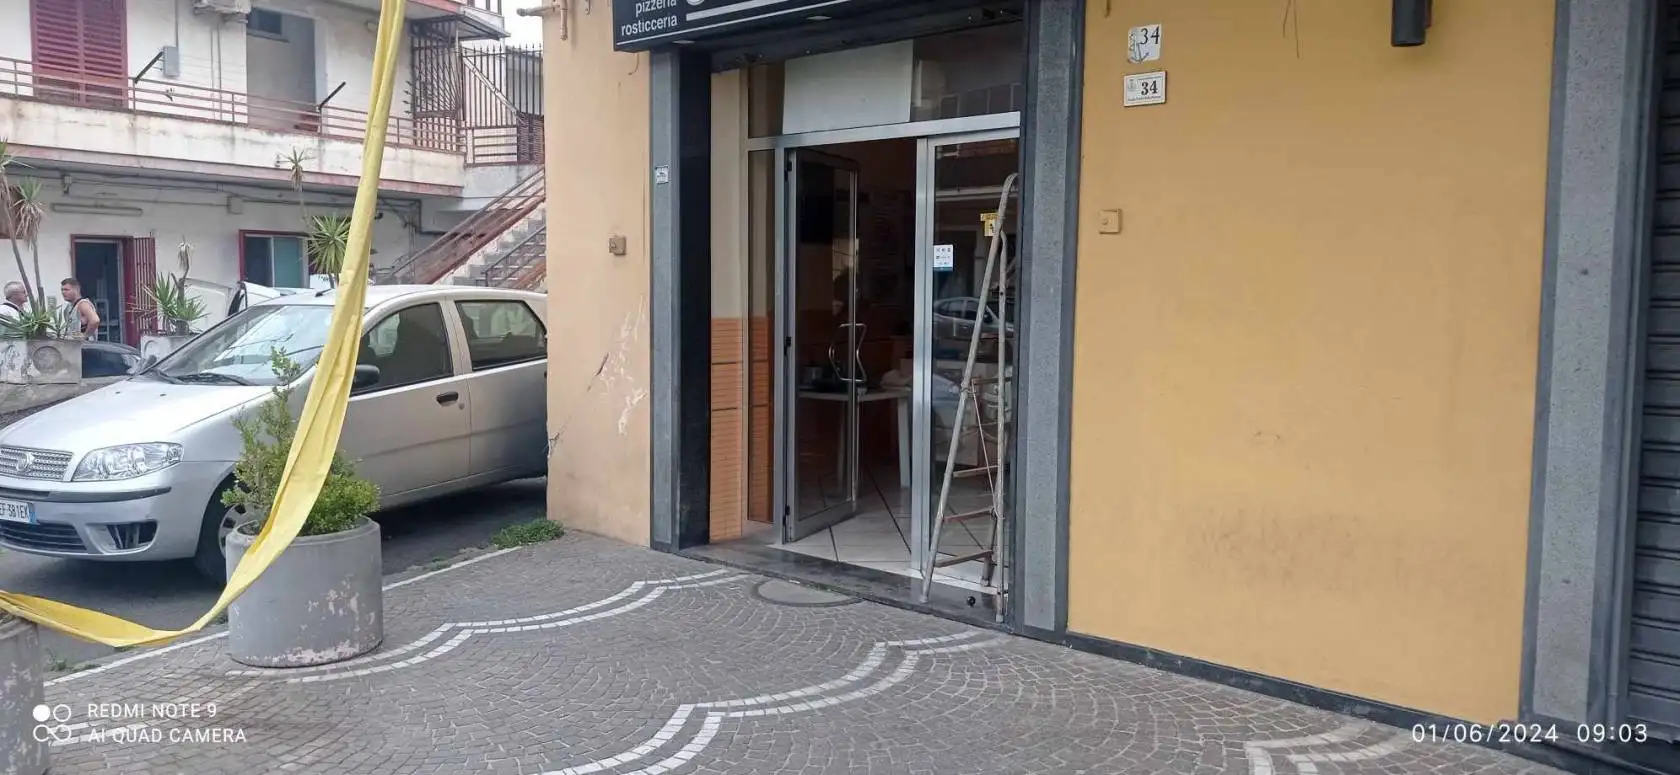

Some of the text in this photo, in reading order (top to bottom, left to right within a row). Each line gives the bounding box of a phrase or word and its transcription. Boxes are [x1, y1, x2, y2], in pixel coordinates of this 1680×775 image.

[635, 0, 677, 17] pizzeria
[621, 15, 677, 36] rosticceria
[1140, 26, 1160, 45] 34
[1141, 80, 1158, 95] 34
